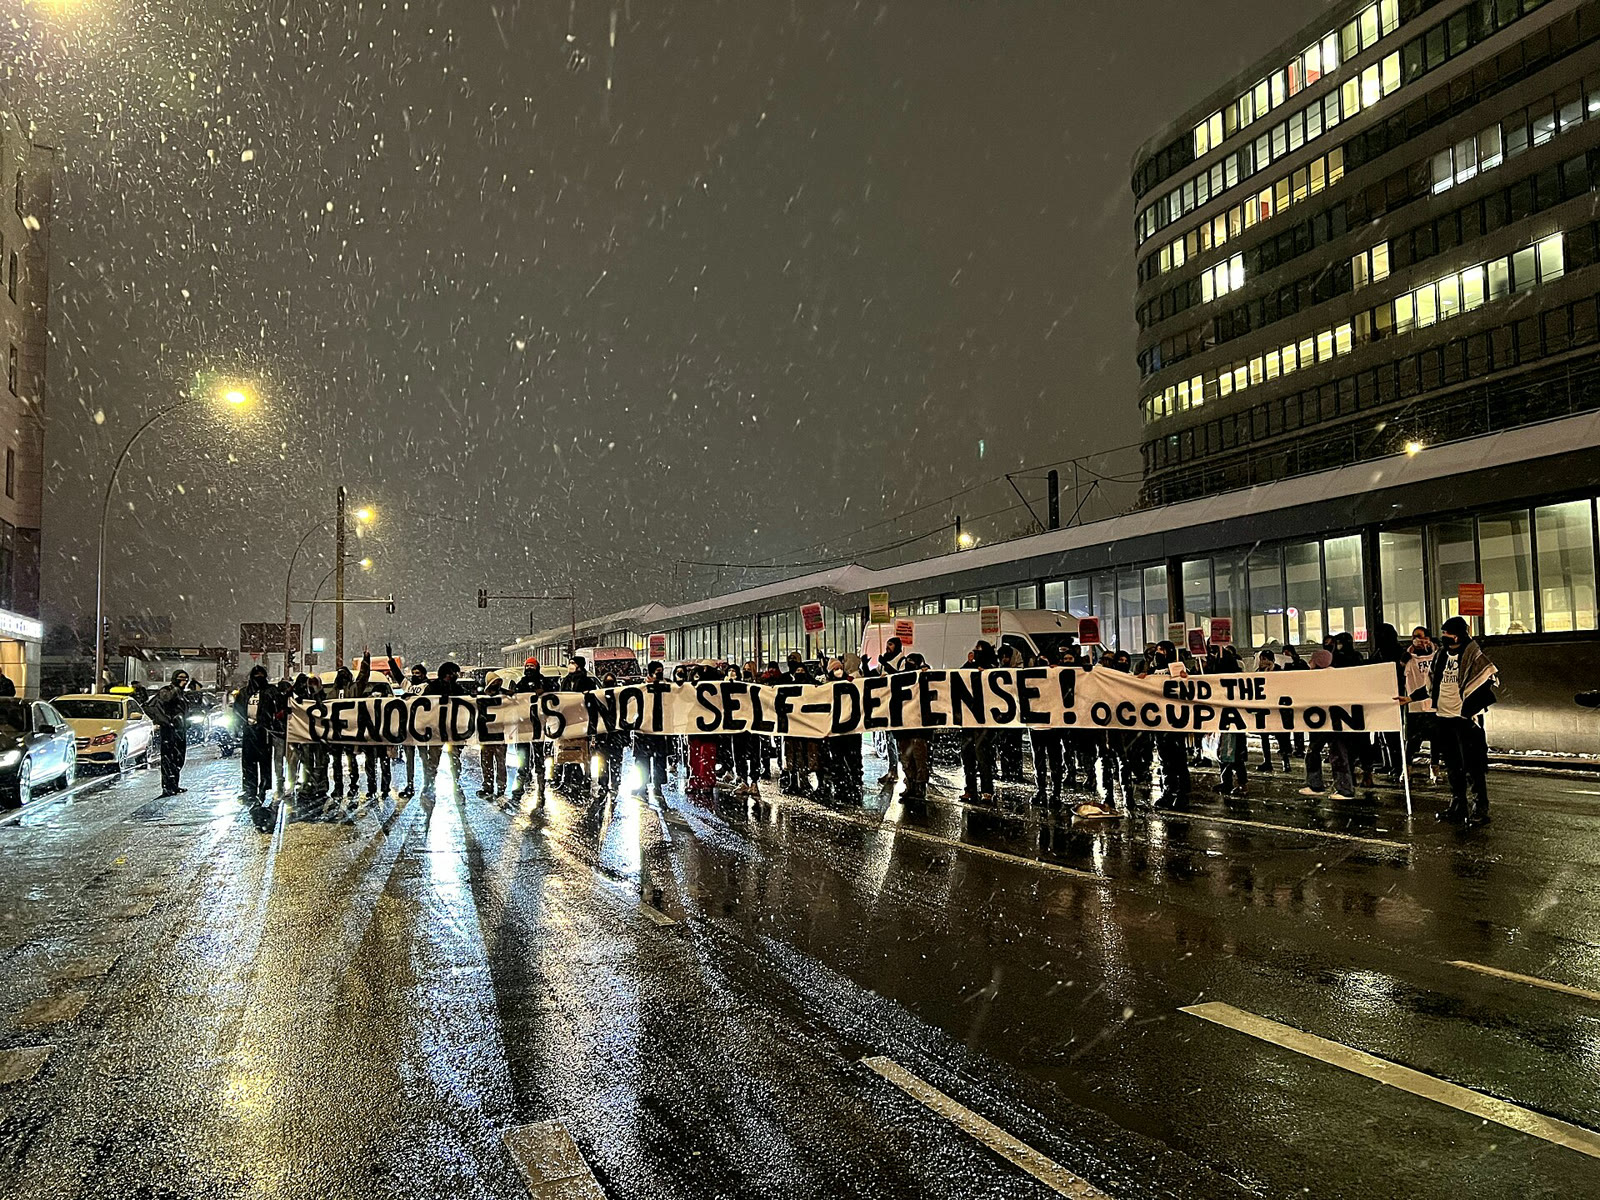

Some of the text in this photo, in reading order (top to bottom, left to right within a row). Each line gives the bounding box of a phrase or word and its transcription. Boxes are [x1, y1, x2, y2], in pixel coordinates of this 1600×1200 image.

[1163, 677, 1267, 701] END THE
[584, 683, 671, 735] NOT
